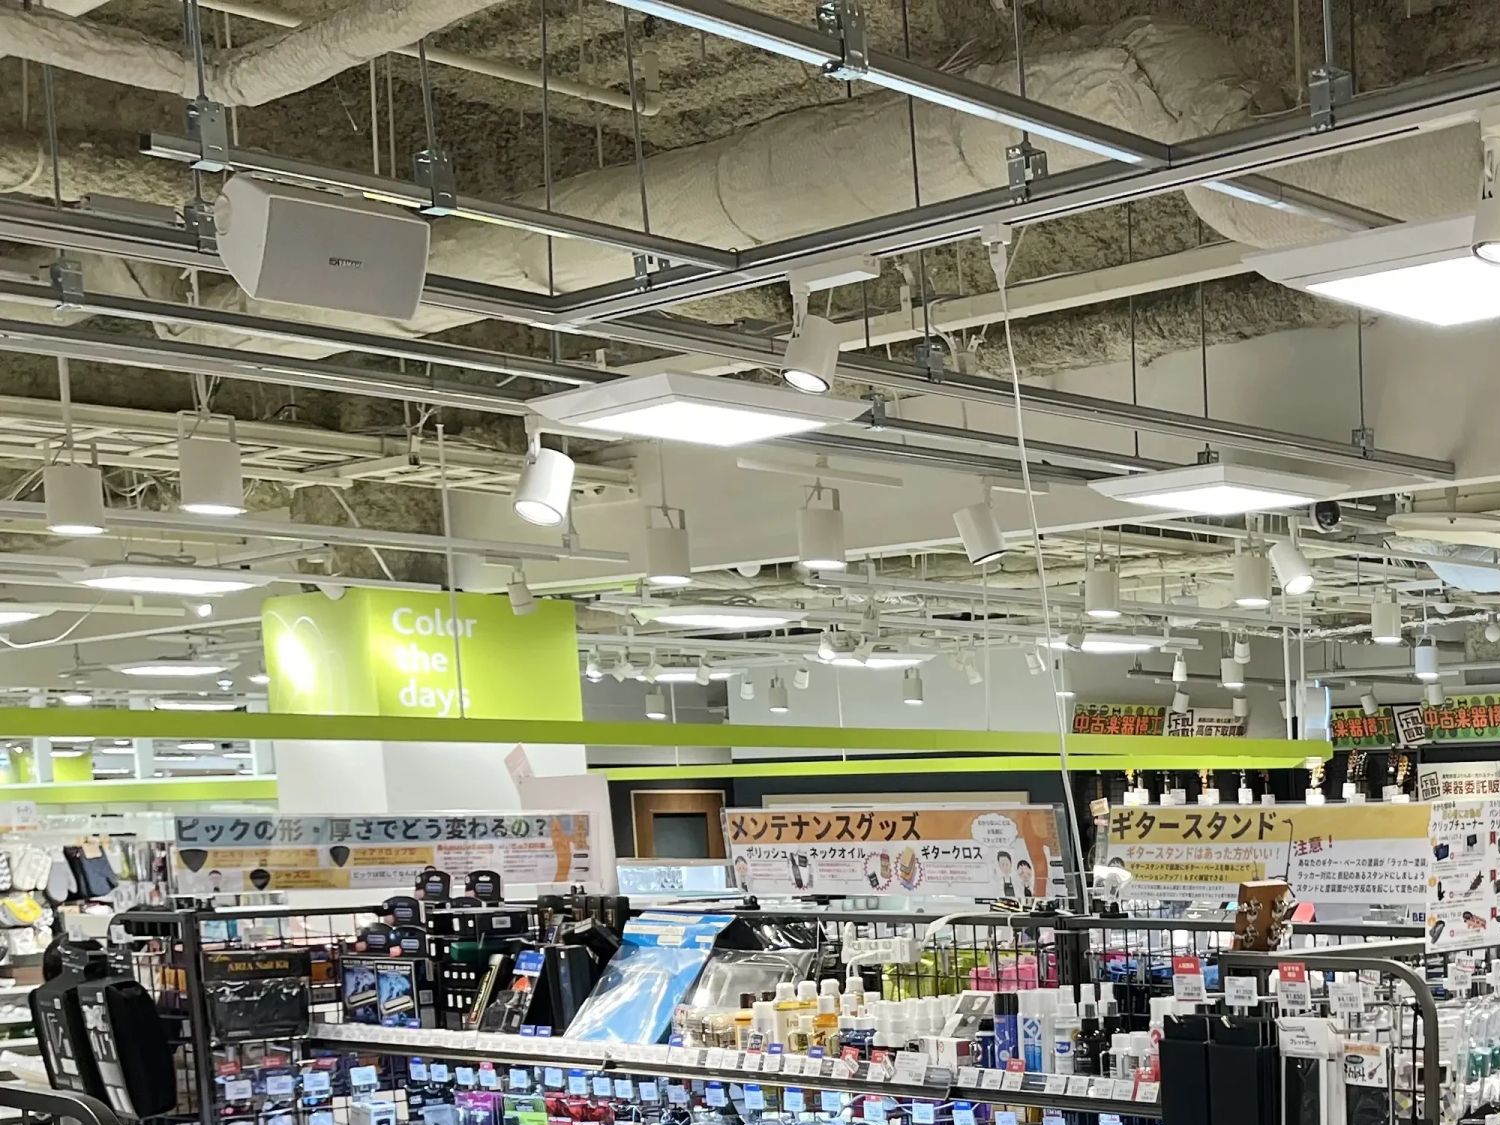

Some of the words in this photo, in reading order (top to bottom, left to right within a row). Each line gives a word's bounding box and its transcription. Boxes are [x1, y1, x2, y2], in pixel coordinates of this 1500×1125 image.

[392, 606, 477, 639] Color
[401, 643, 448, 672] the
[399, 679, 471, 718] days
[731, 811, 921, 842] メンテナンスグッズ
[1111, 810, 1277, 841] ギタースタンド
[809, 846, 866, 860] ネックオイル
[921, 845, 983, 861] ギタークロス
[1293, 834, 1334, 857] 注意！
